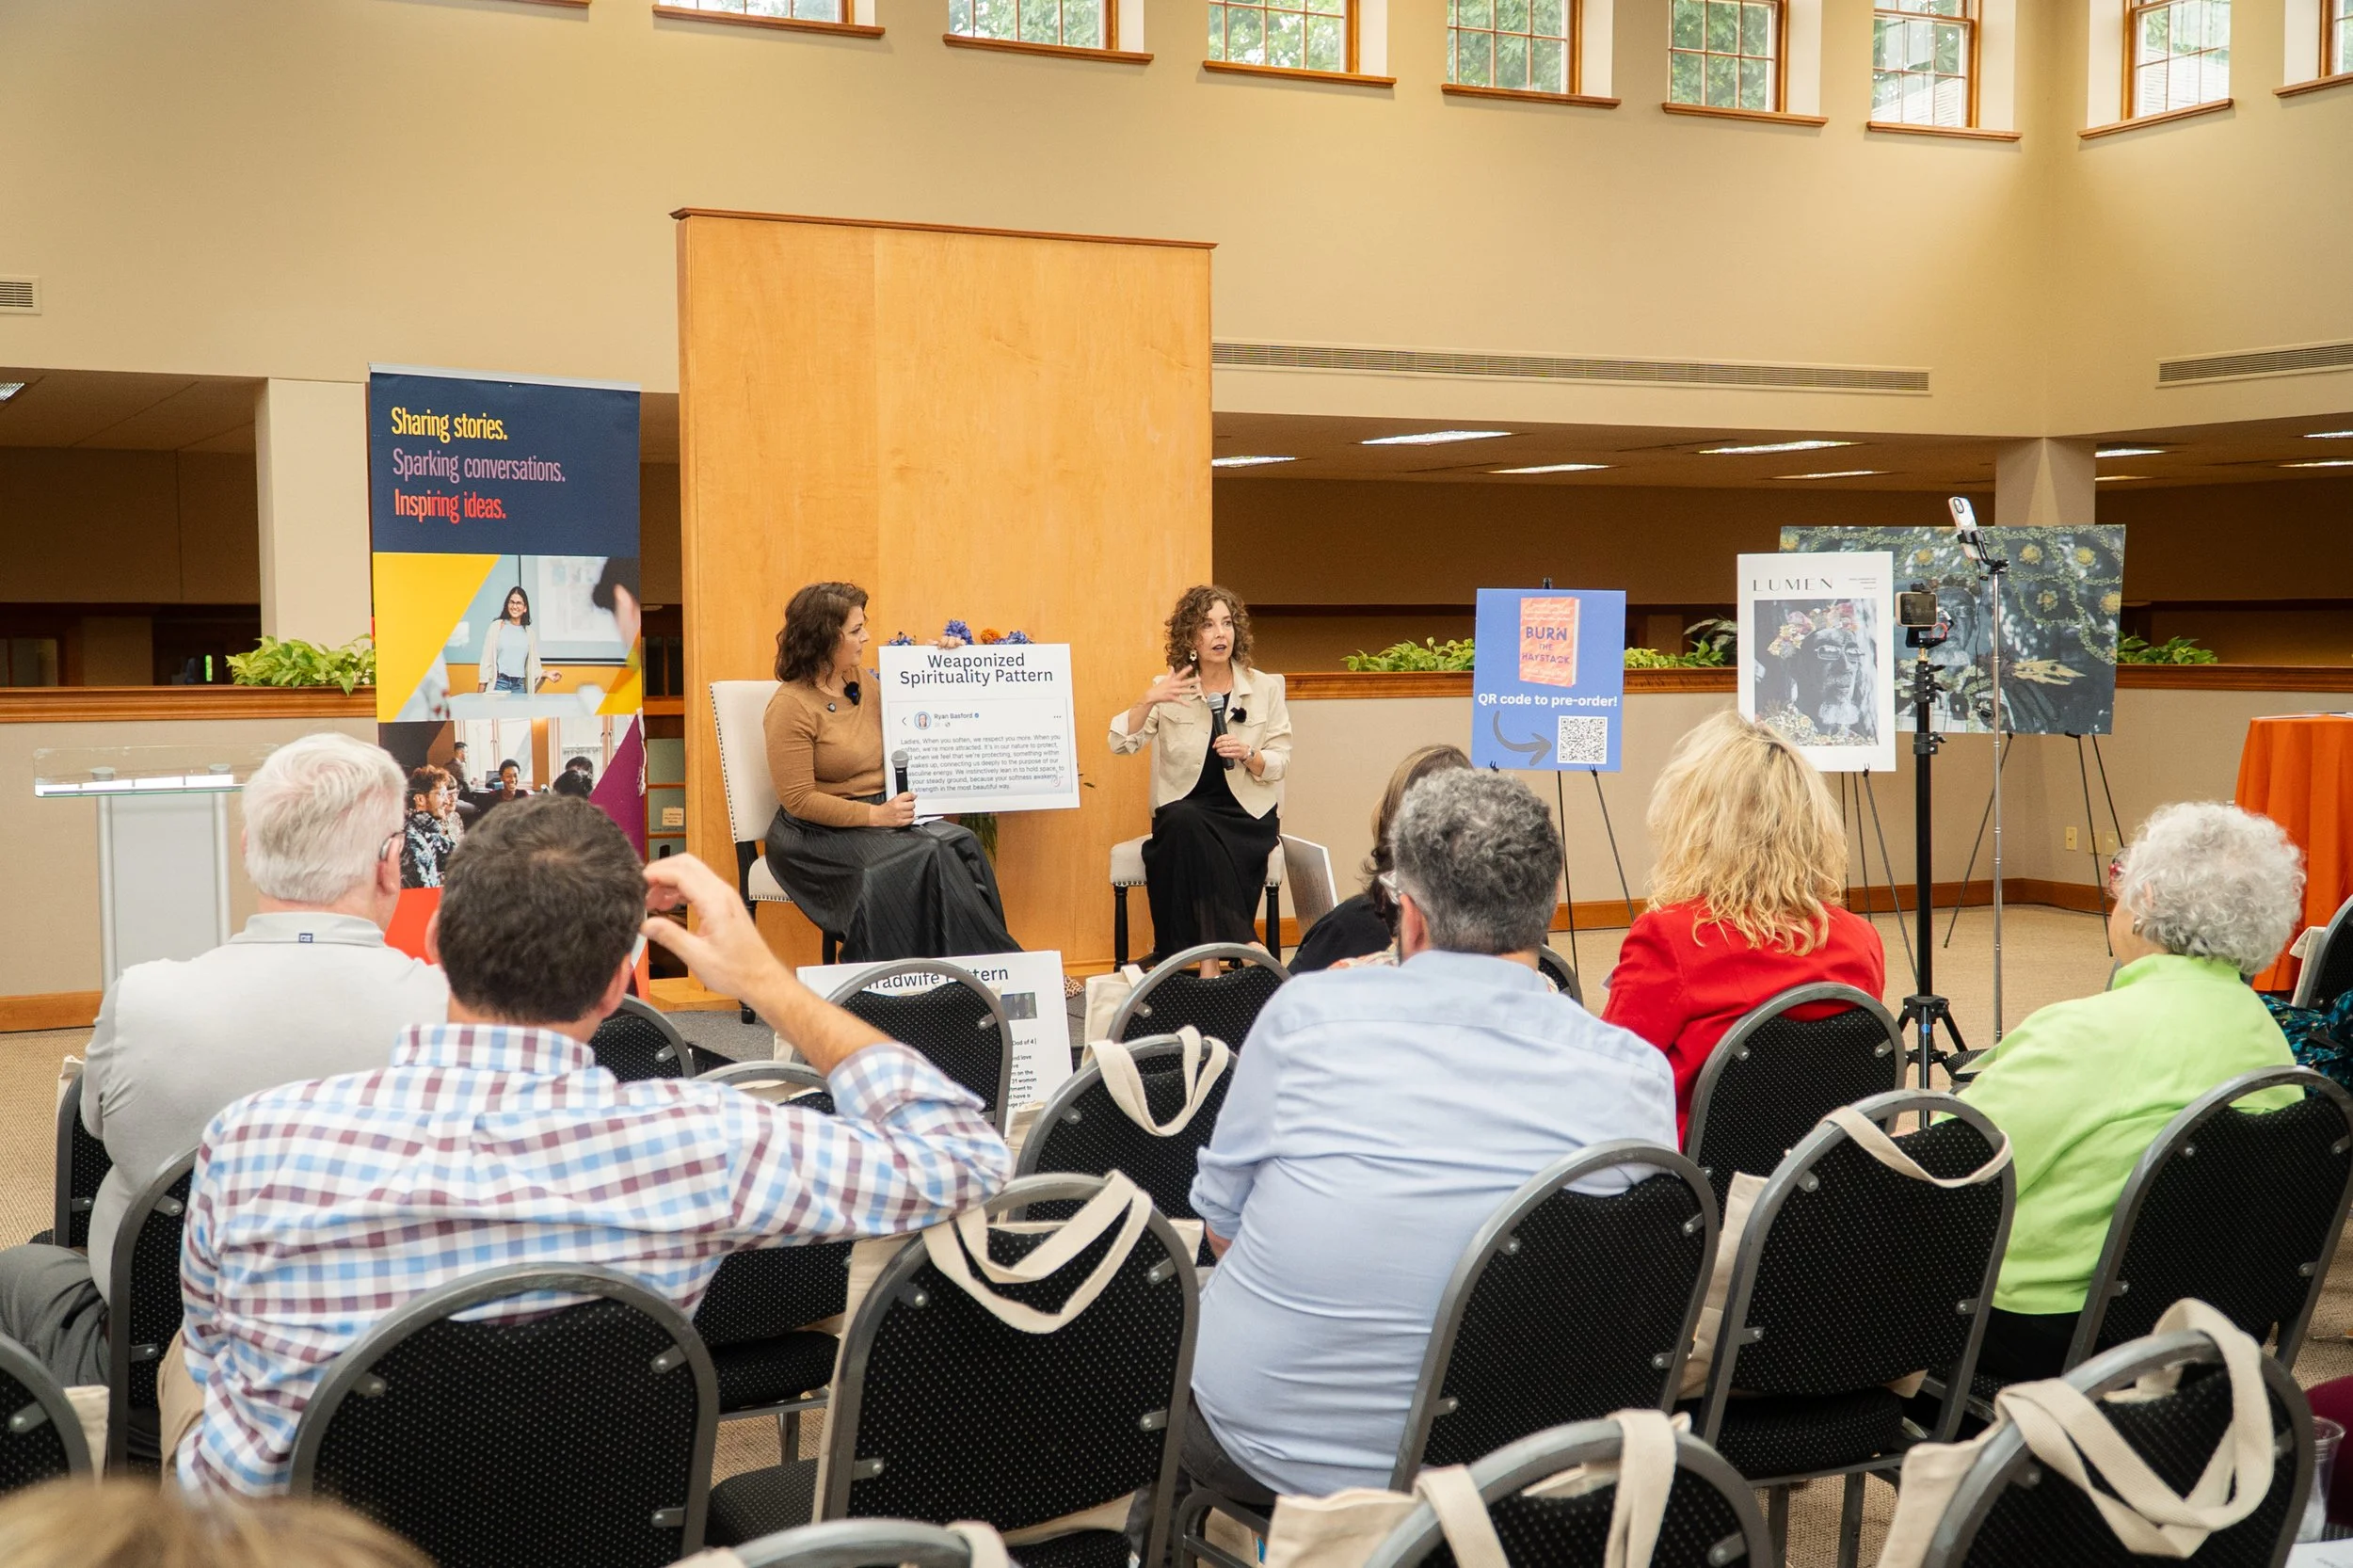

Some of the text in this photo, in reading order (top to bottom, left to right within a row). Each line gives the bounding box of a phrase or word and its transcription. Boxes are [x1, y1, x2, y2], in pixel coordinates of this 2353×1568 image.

[391, 407, 508, 444] Sharing stories.
[392, 447, 567, 484] Sparking conversations.
[394, 488, 507, 524] Inspiring ideas.
[1753, 578, 1833, 592] LUMEN
[1526, 626, 1567, 641] BURN
[1539, 643, 1553, 651] THE
[927, 652, 1025, 671] Weaponized
[1521, 652, 1570, 664] HAYSTACK
[900, 669, 1053, 688] Spirituality Pattern
[1478, 694, 1618, 709] QR code to pre-order!
[914, 785, 939, 793] strength
